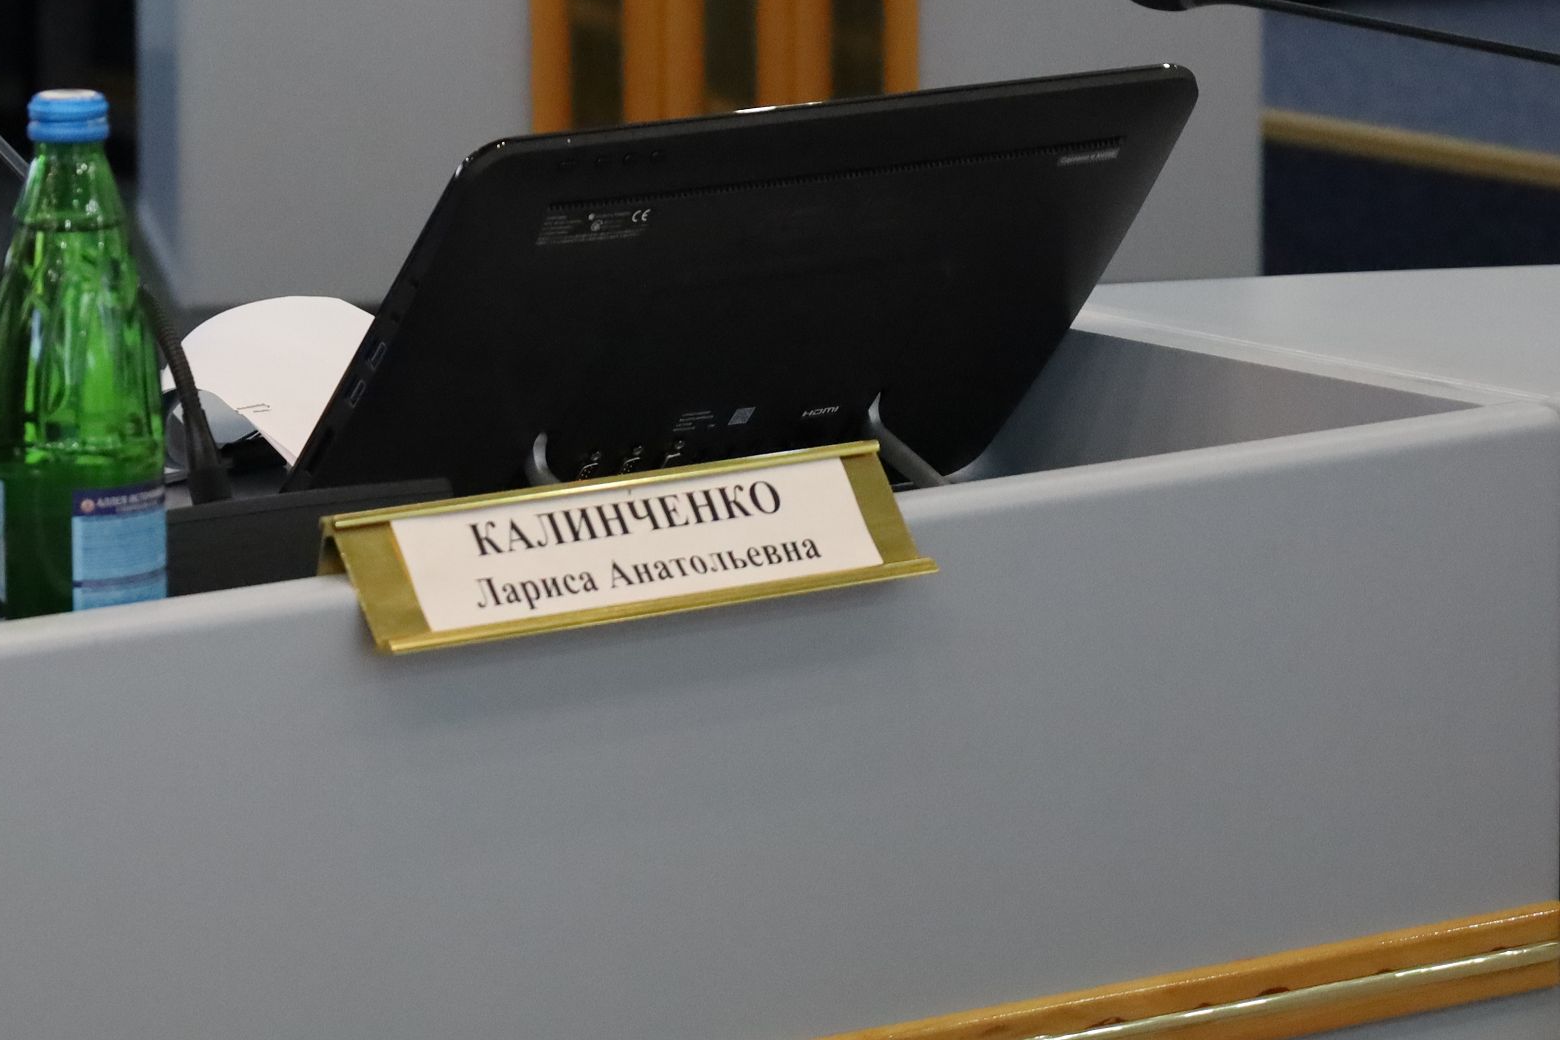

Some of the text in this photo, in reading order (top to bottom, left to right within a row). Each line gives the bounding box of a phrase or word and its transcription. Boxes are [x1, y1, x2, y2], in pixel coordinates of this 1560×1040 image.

[468, 480, 783, 557] КАЛИНЧЕНКО
[475, 537, 823, 610] Лариса Анатольевна
